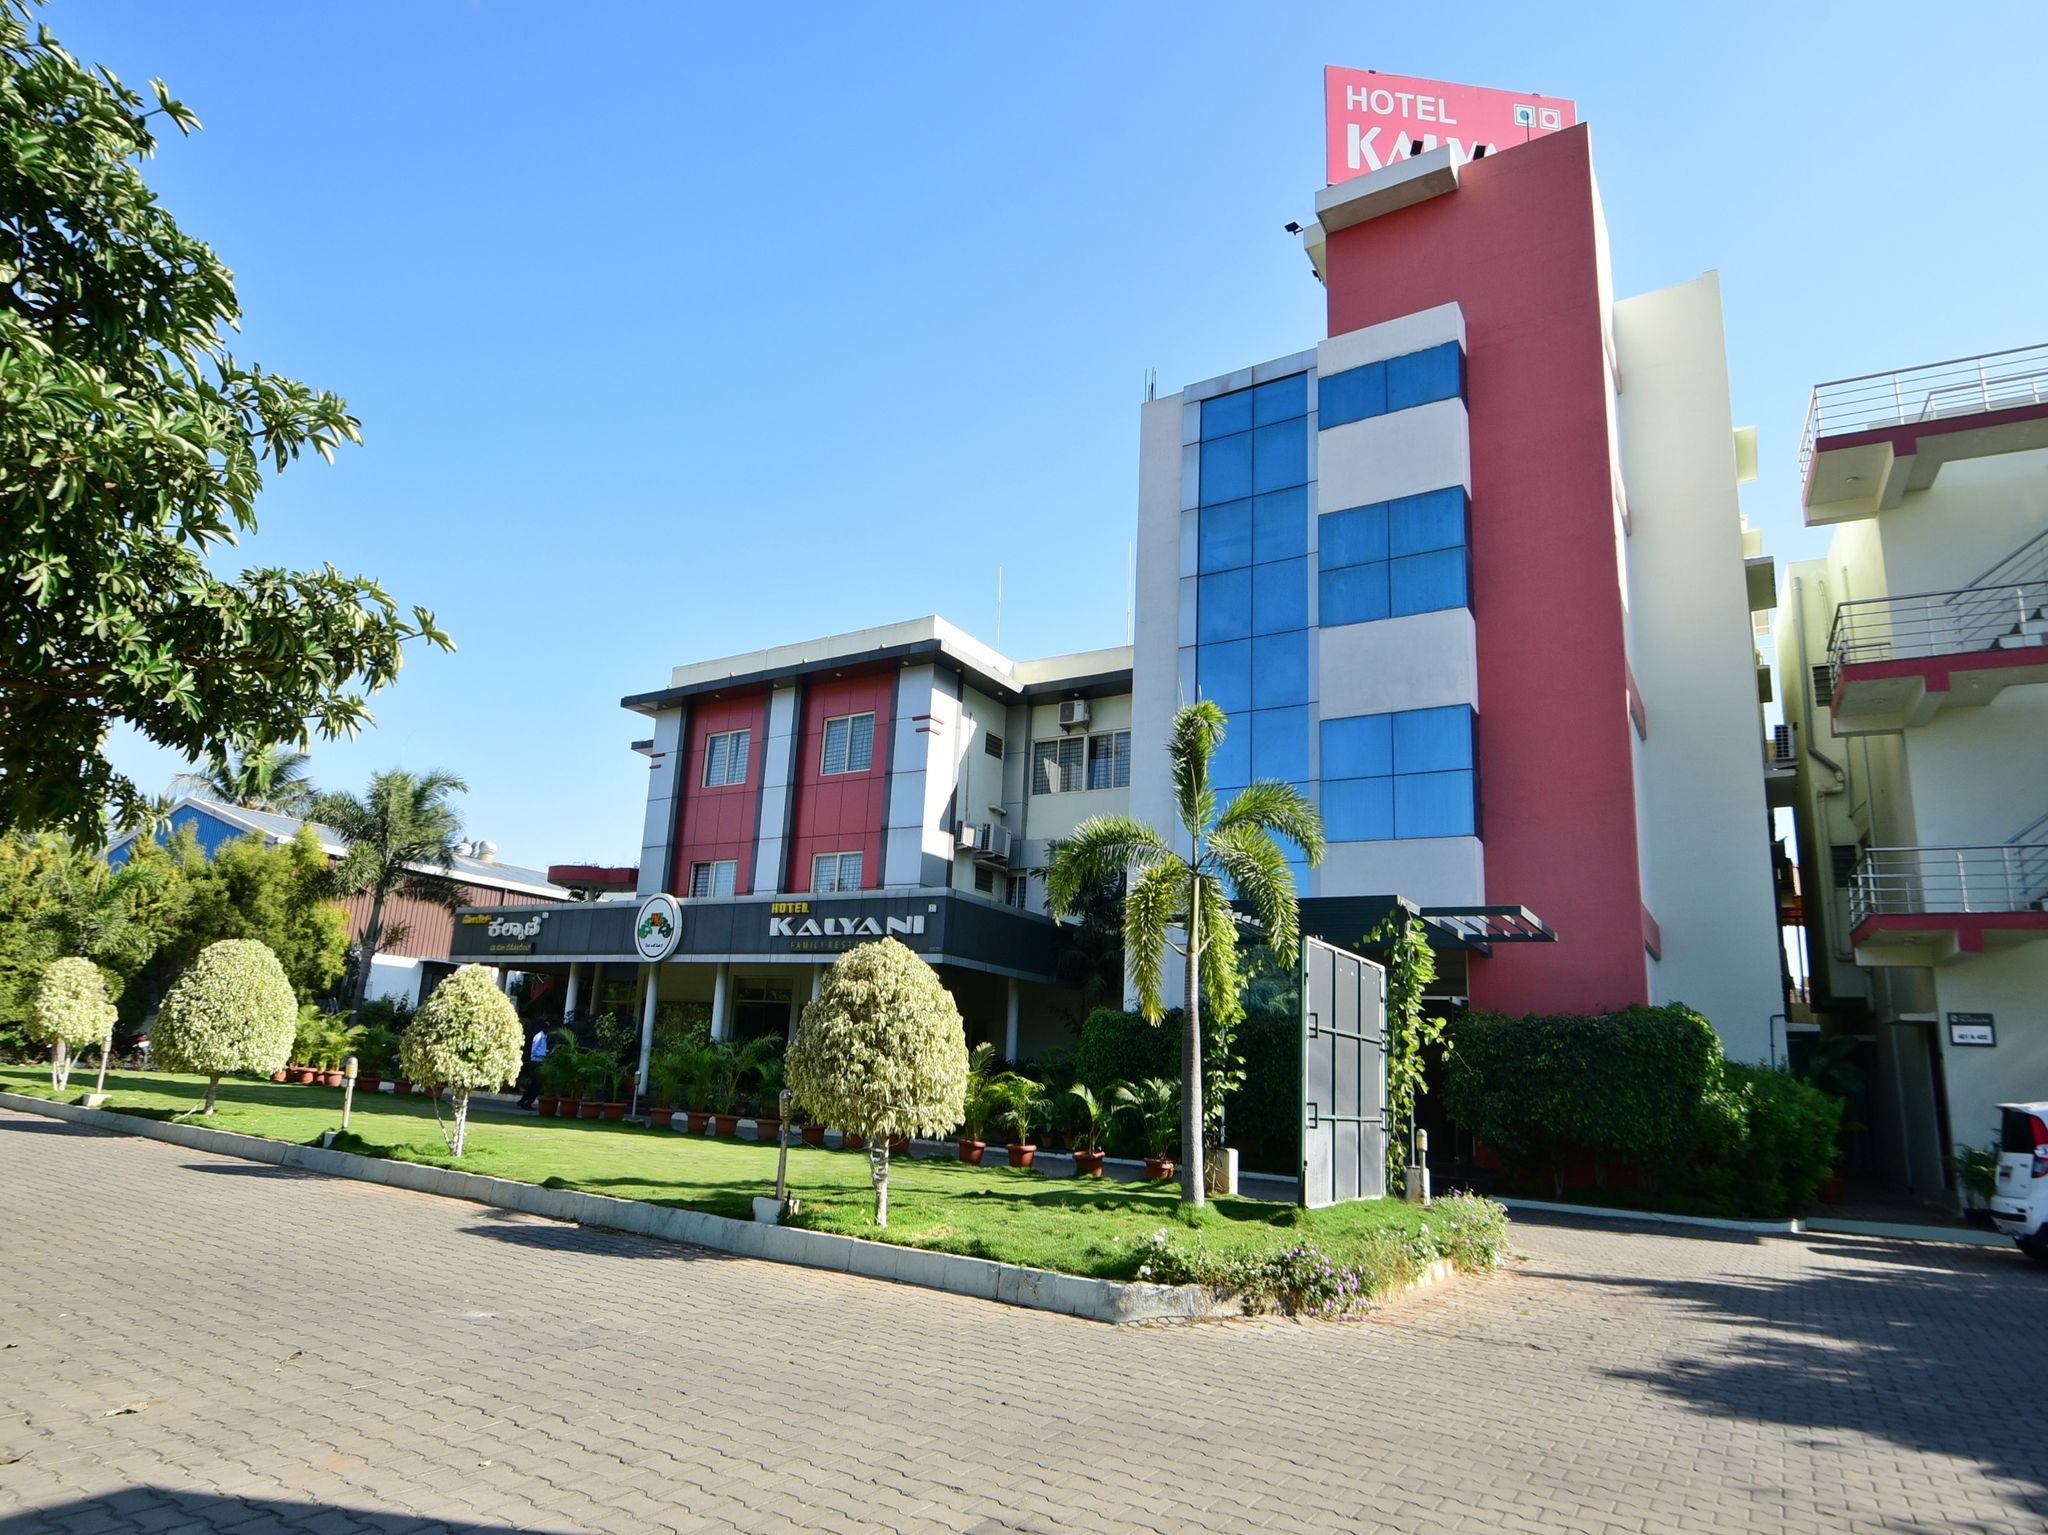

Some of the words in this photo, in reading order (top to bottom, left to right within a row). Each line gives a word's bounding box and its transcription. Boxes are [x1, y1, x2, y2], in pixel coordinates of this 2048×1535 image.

[1346, 85, 1457, 124] HOTEL
[771, 902, 810, 914] HOTEL
[769, 915, 925, 937] KALYANI
[790, 941, 824, 950] FAMILY
